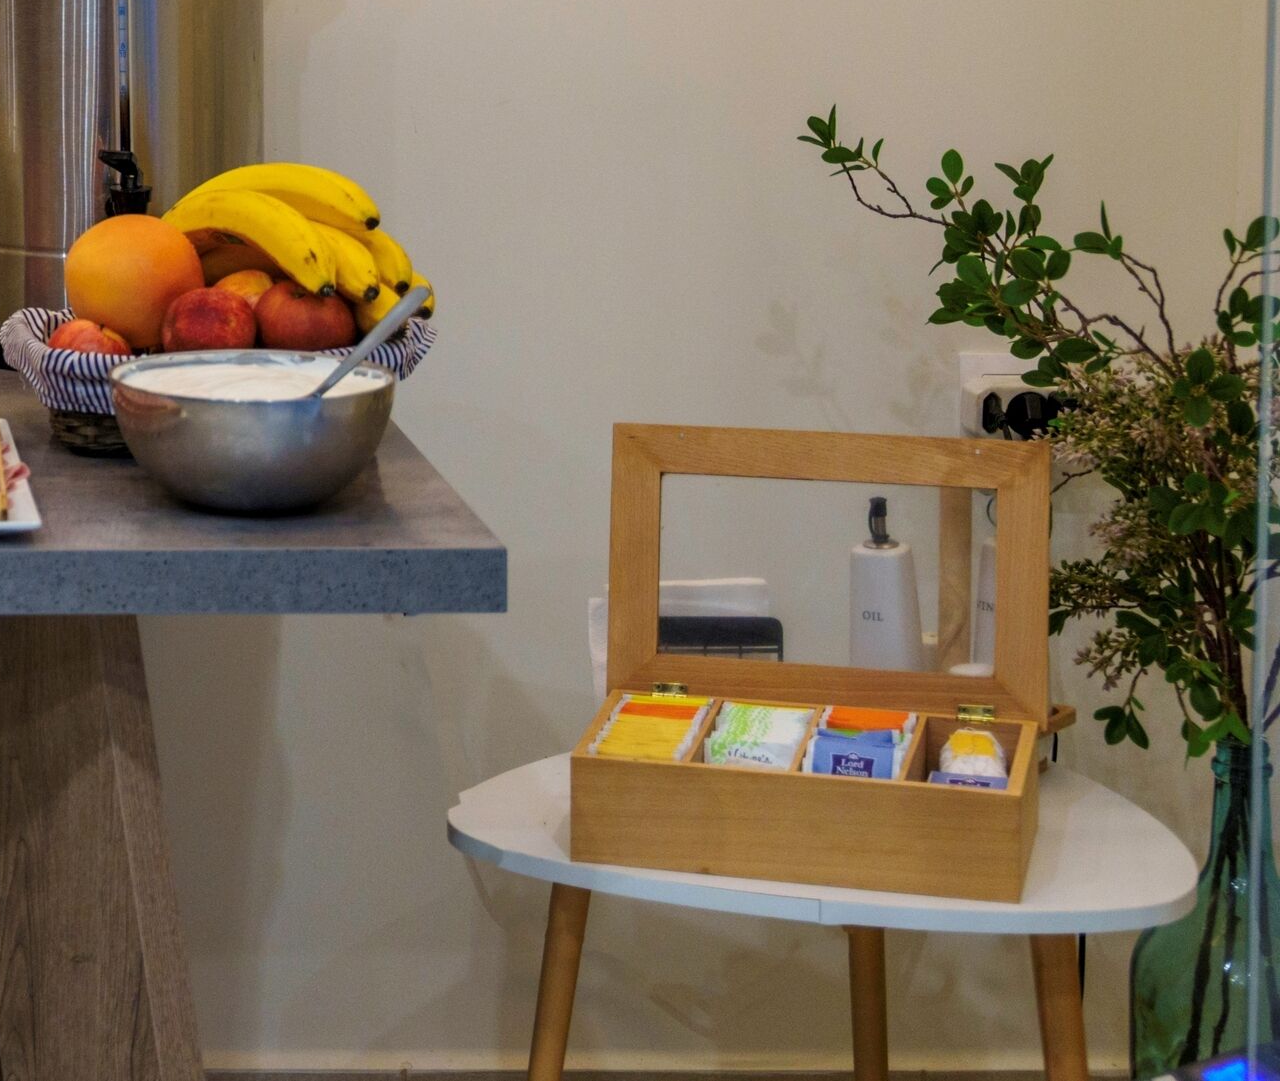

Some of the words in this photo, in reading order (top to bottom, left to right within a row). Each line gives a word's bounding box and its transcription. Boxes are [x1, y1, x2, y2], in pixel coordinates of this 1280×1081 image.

[862, 610, 884, 622] OIL
[840, 758, 865, 769] Lord
[835, 765, 869, 778] Nelson
